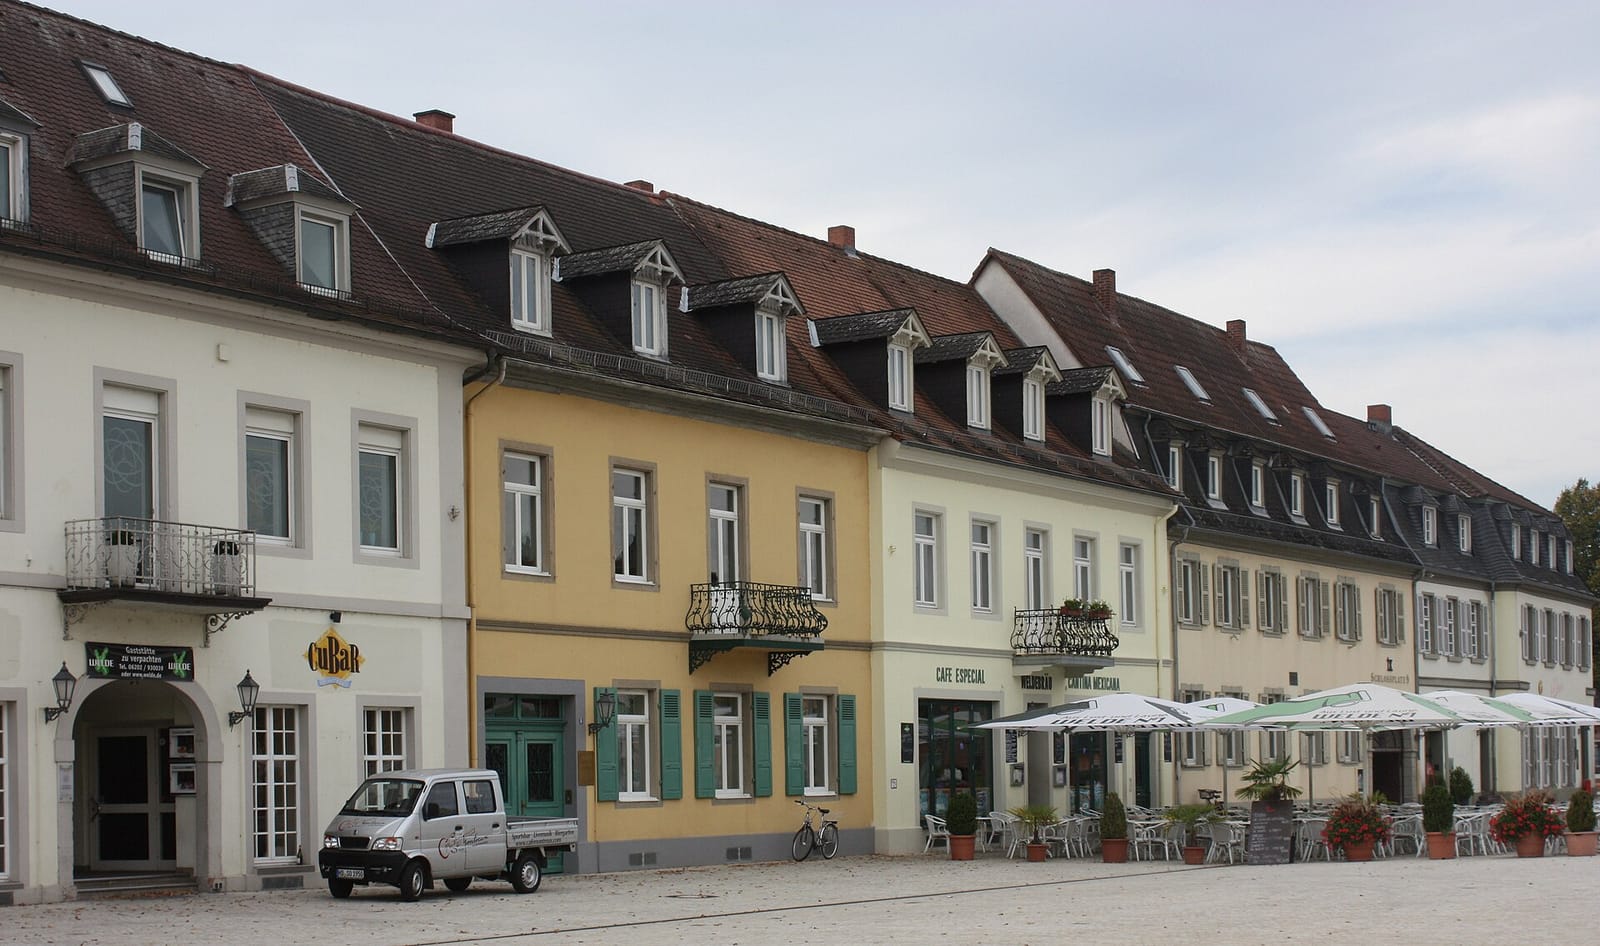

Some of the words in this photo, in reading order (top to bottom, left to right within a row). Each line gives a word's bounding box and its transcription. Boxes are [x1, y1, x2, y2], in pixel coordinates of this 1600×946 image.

[126, 646, 156, 655] Gaststätte
[130, 655, 162, 664] verpachten
[936, 666, 952, 682] CAFE
[955, 668, 986, 684] ESPECIAL
[1067, 676, 1092, 690] CANTINA
[1093, 676, 1120, 691] MEXICANA
